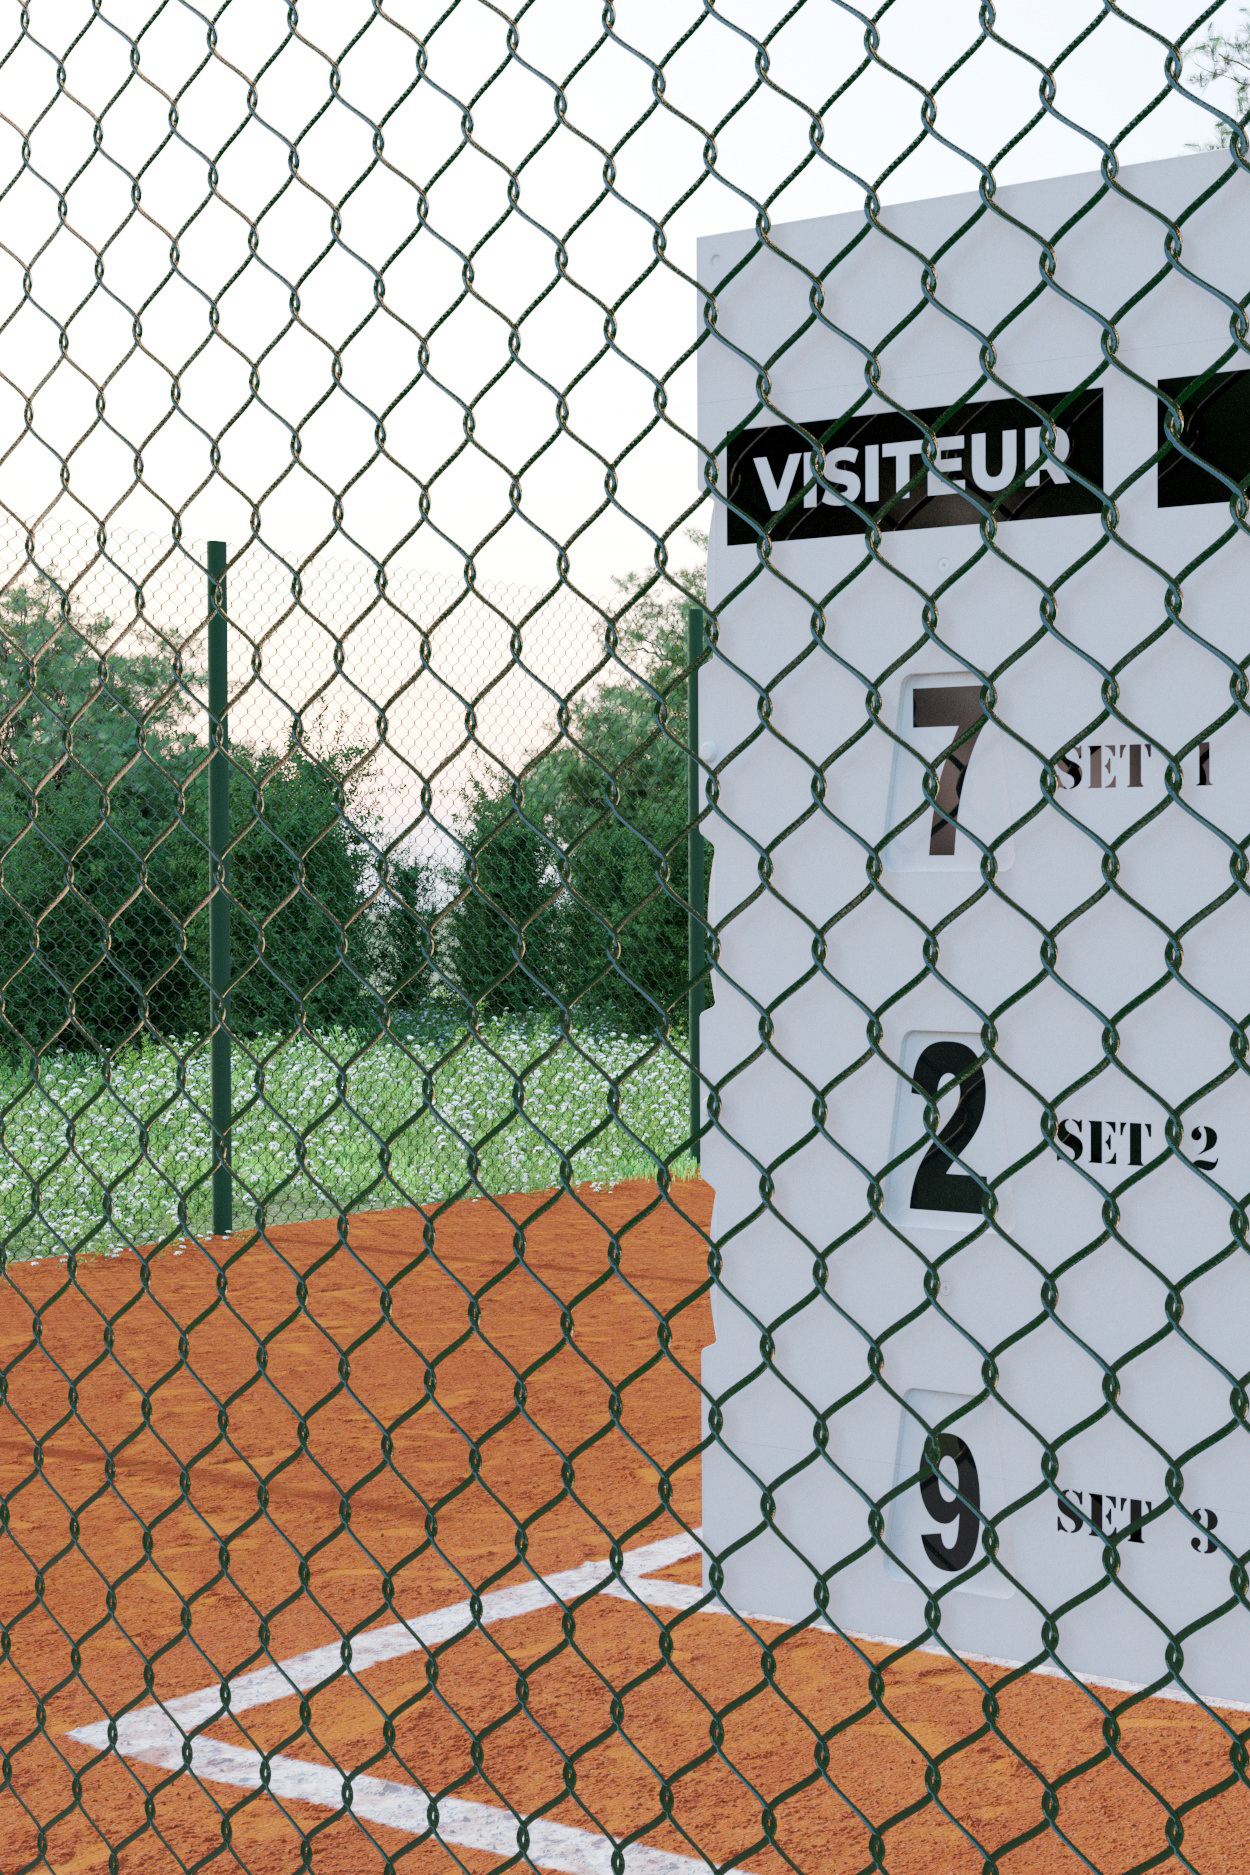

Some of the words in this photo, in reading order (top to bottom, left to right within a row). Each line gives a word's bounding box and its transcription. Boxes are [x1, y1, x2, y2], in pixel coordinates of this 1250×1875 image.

[752, 426, 1071, 512] VISITEUR
[912, 685, 992, 856] 7
[1056, 743, 1152, 790] SET
[1195, 741, 1214, 787] 1
[909, 1040, 988, 1215] 2
[1056, 1118, 1152, 1167] SET
[1190, 1125, 1219, 1172] 2
[918, 1432, 981, 1573] 9
[1056, 1488, 1152, 1544] SET
[1190, 1507, 1219, 1554] 3
